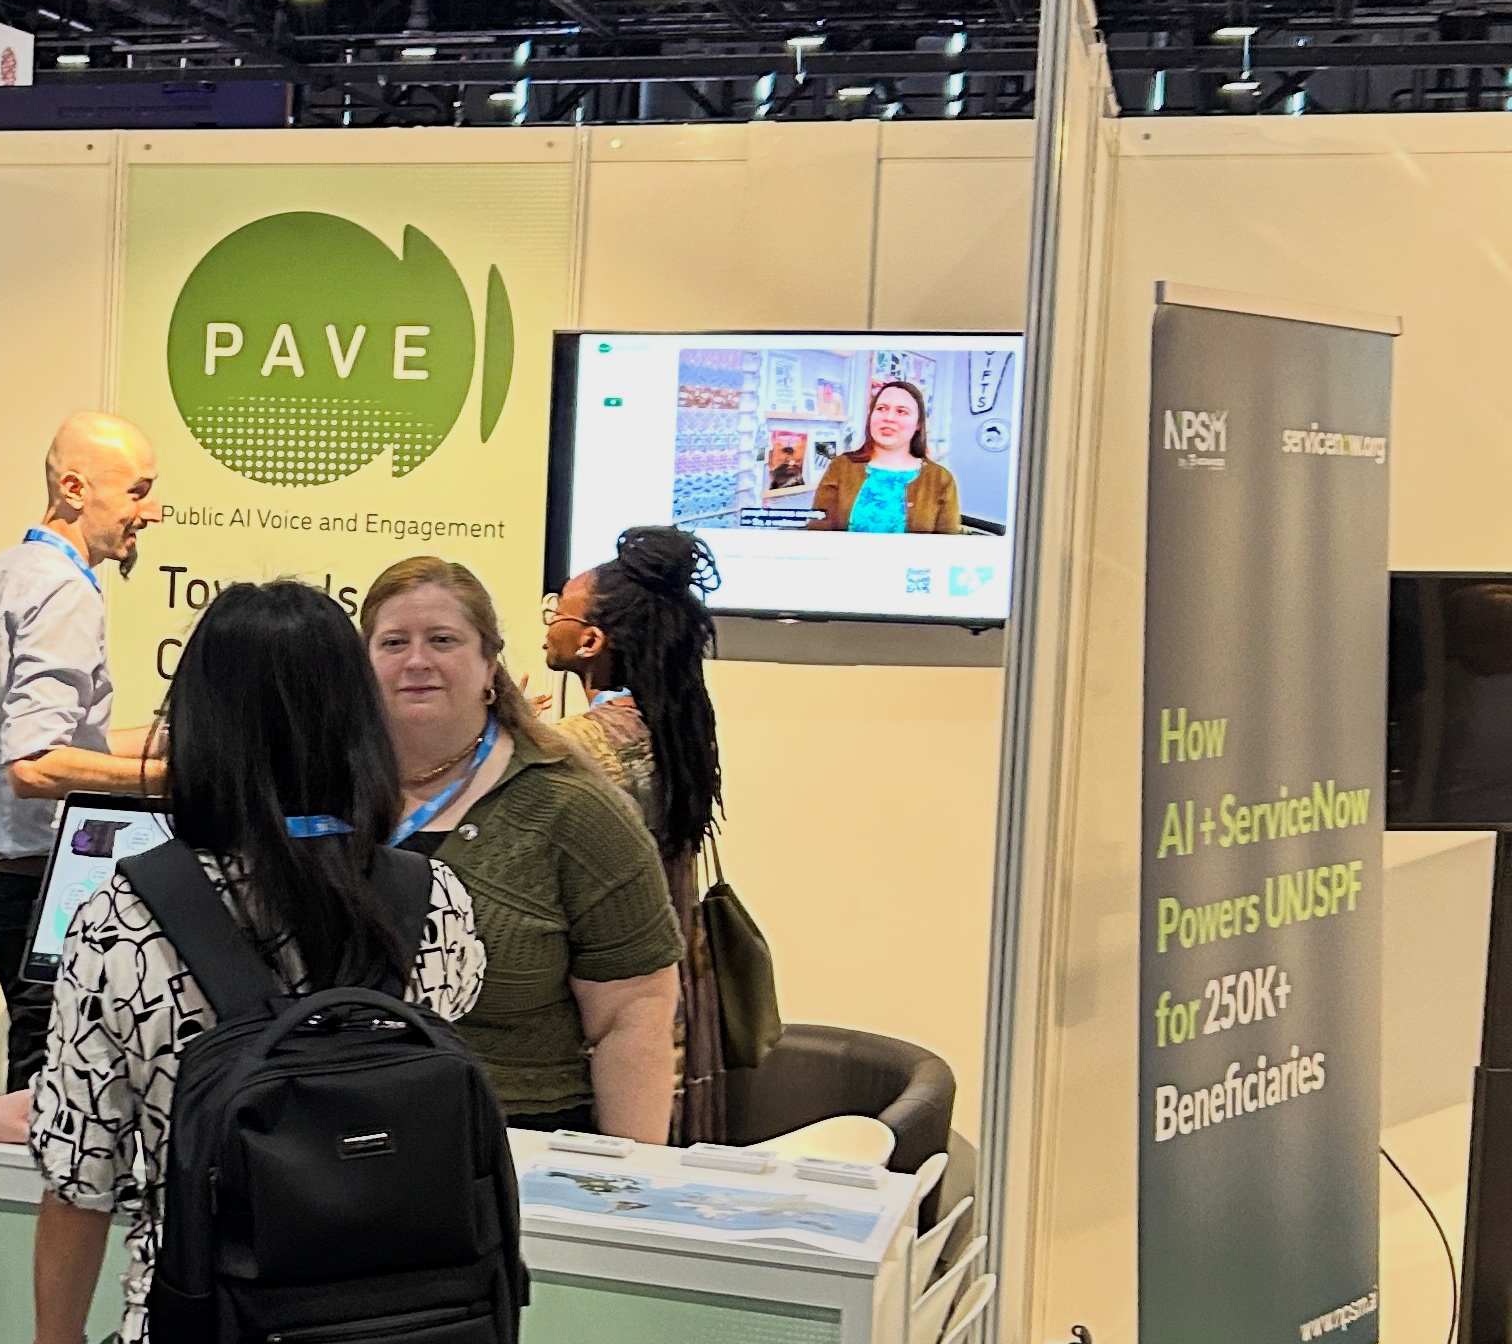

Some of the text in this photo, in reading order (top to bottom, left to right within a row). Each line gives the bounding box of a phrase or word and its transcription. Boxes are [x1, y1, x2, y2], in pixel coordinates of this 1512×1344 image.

[204, 322, 431, 380] PAVE
[977, 350, 996, 408] IFTS
[161, 505, 505, 540] Public AI Voice and Engagement
[1160, 707, 1228, 764] How
[1157, 860, 1363, 953] Powers UNJSPF
[1155, 965, 1291, 1047] for 250K+
[1155, 1044, 1326, 1142] Beneficiaries
